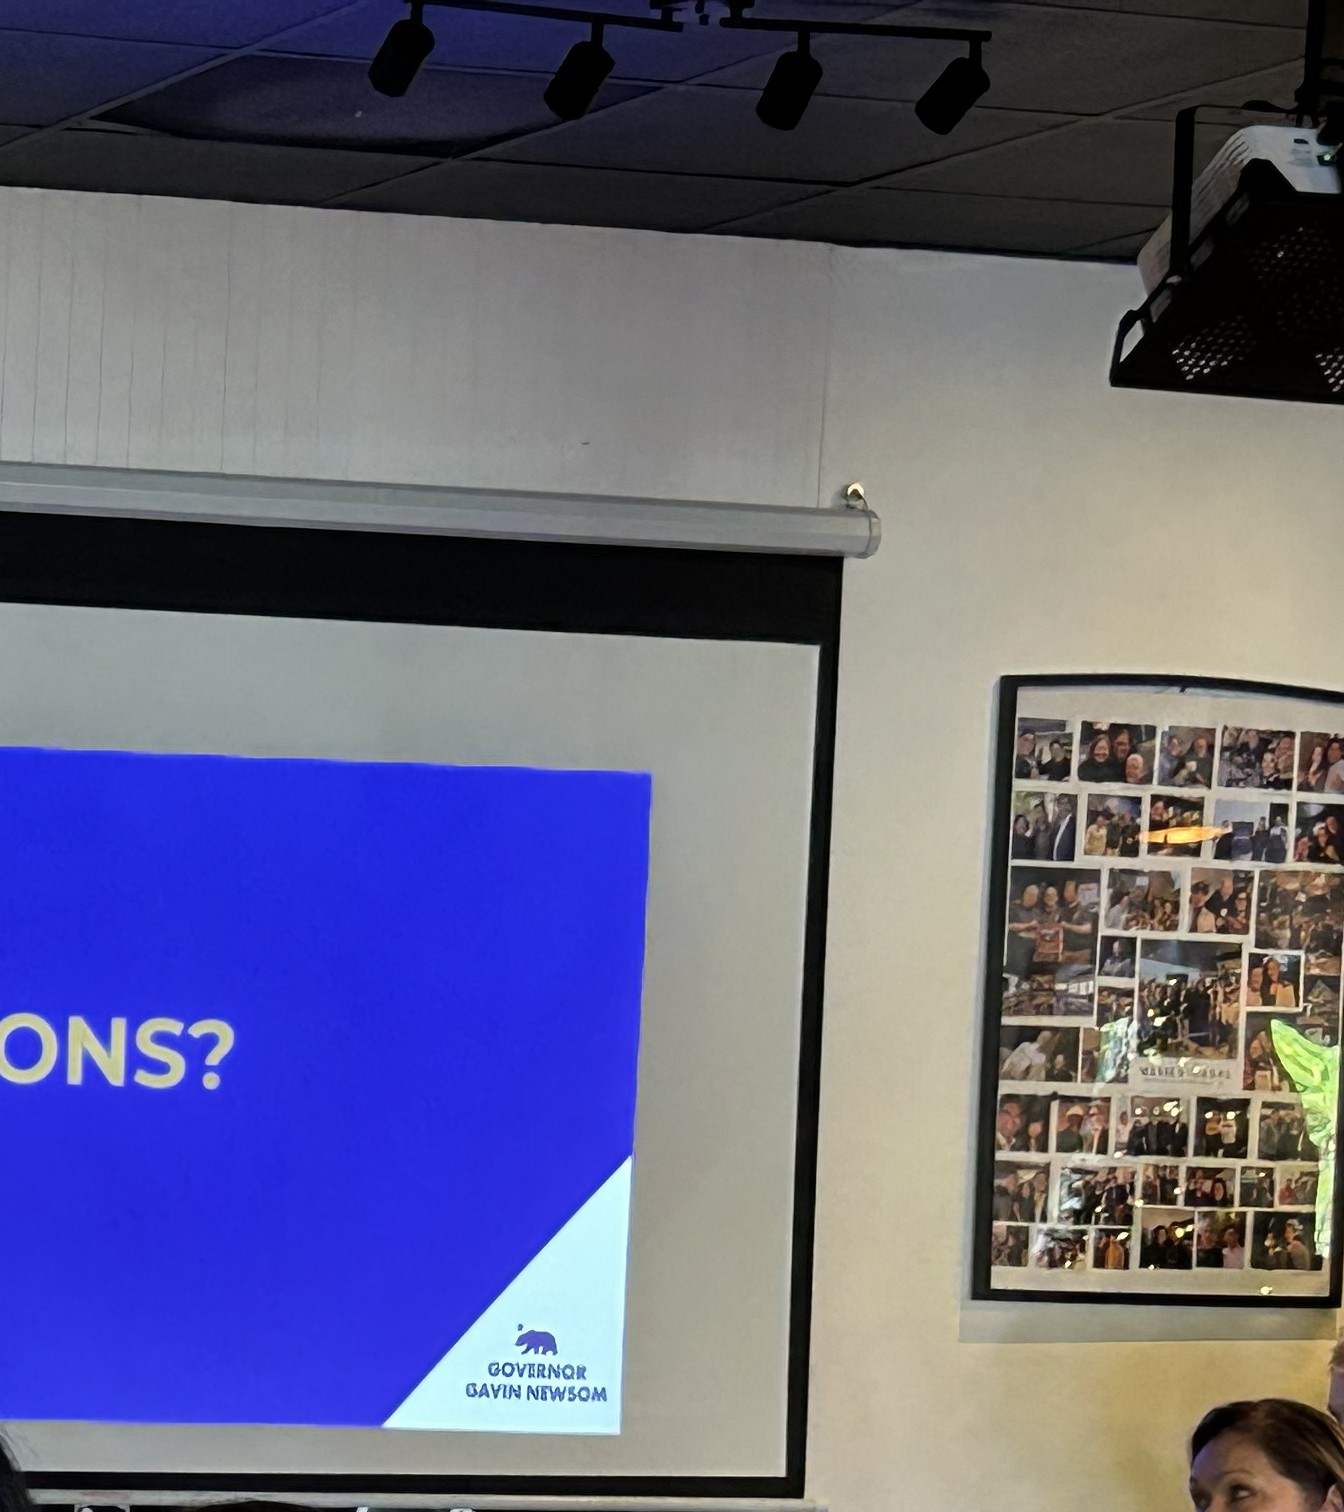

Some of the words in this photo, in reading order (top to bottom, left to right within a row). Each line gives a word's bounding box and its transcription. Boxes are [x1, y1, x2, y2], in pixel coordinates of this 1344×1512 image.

[487, 1361, 587, 1380] GOVERNOR
[465, 1382, 522, 1400] GAVIN
[526, 1384, 608, 1402] NEWSOM
